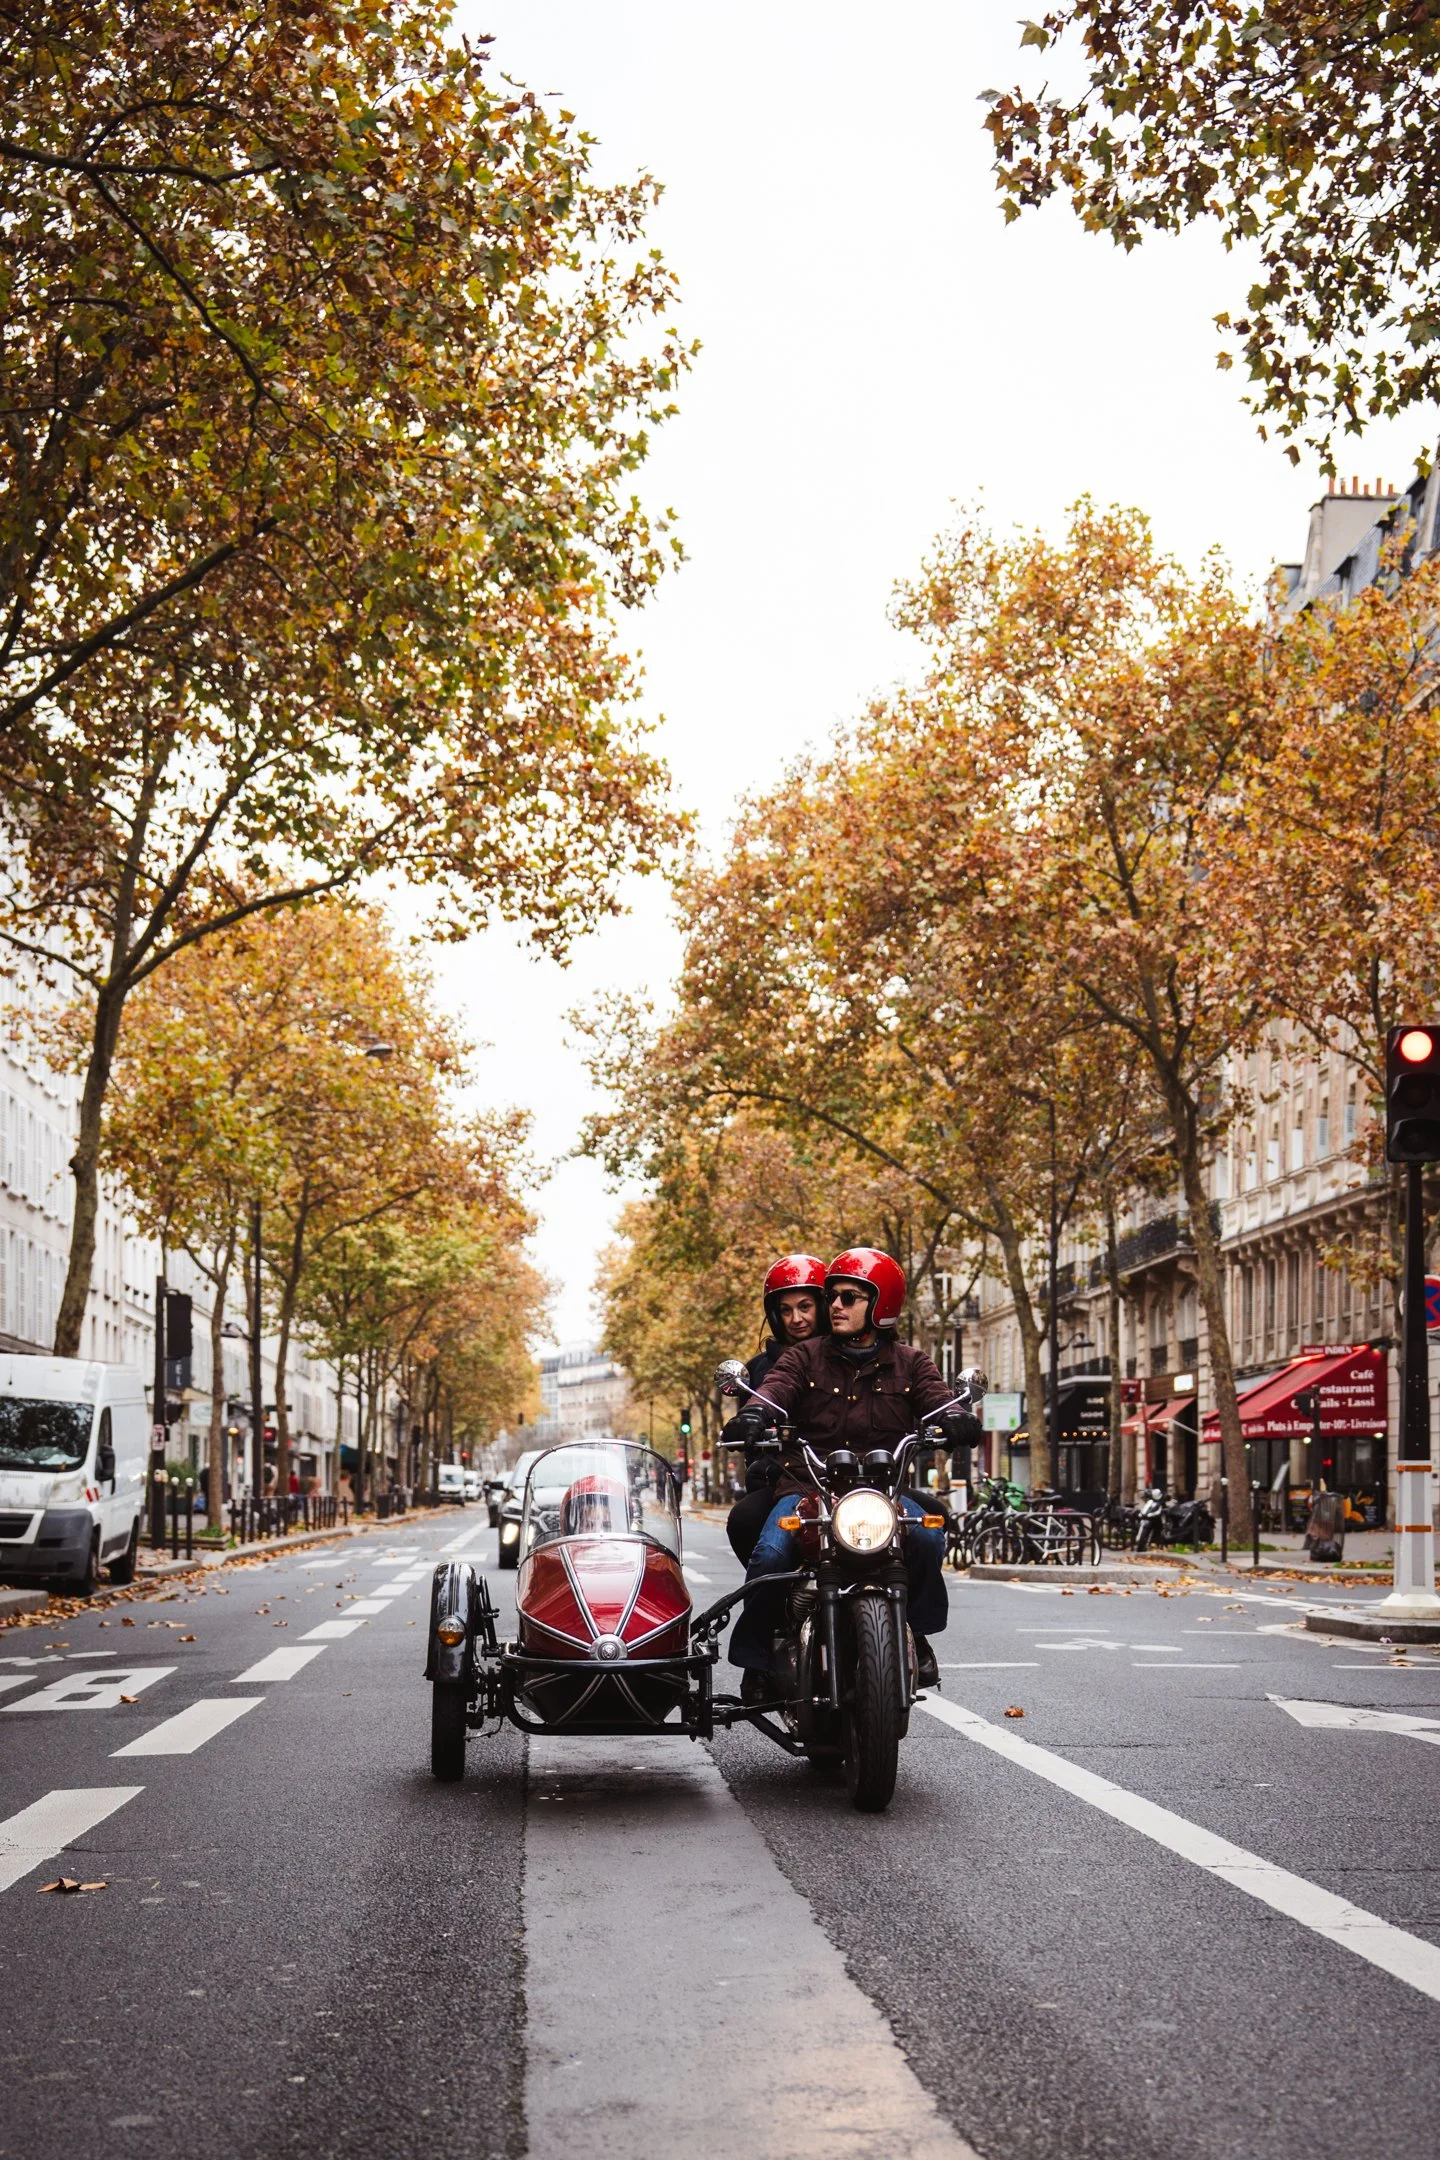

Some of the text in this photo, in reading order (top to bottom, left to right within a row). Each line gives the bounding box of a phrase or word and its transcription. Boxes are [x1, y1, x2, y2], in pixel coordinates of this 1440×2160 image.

[1350, 1370, 1374, 1380] Café
[1314, 1384, 1375, 1394] estaurant
[1347, 1397, 1375, 1408] Lassi
